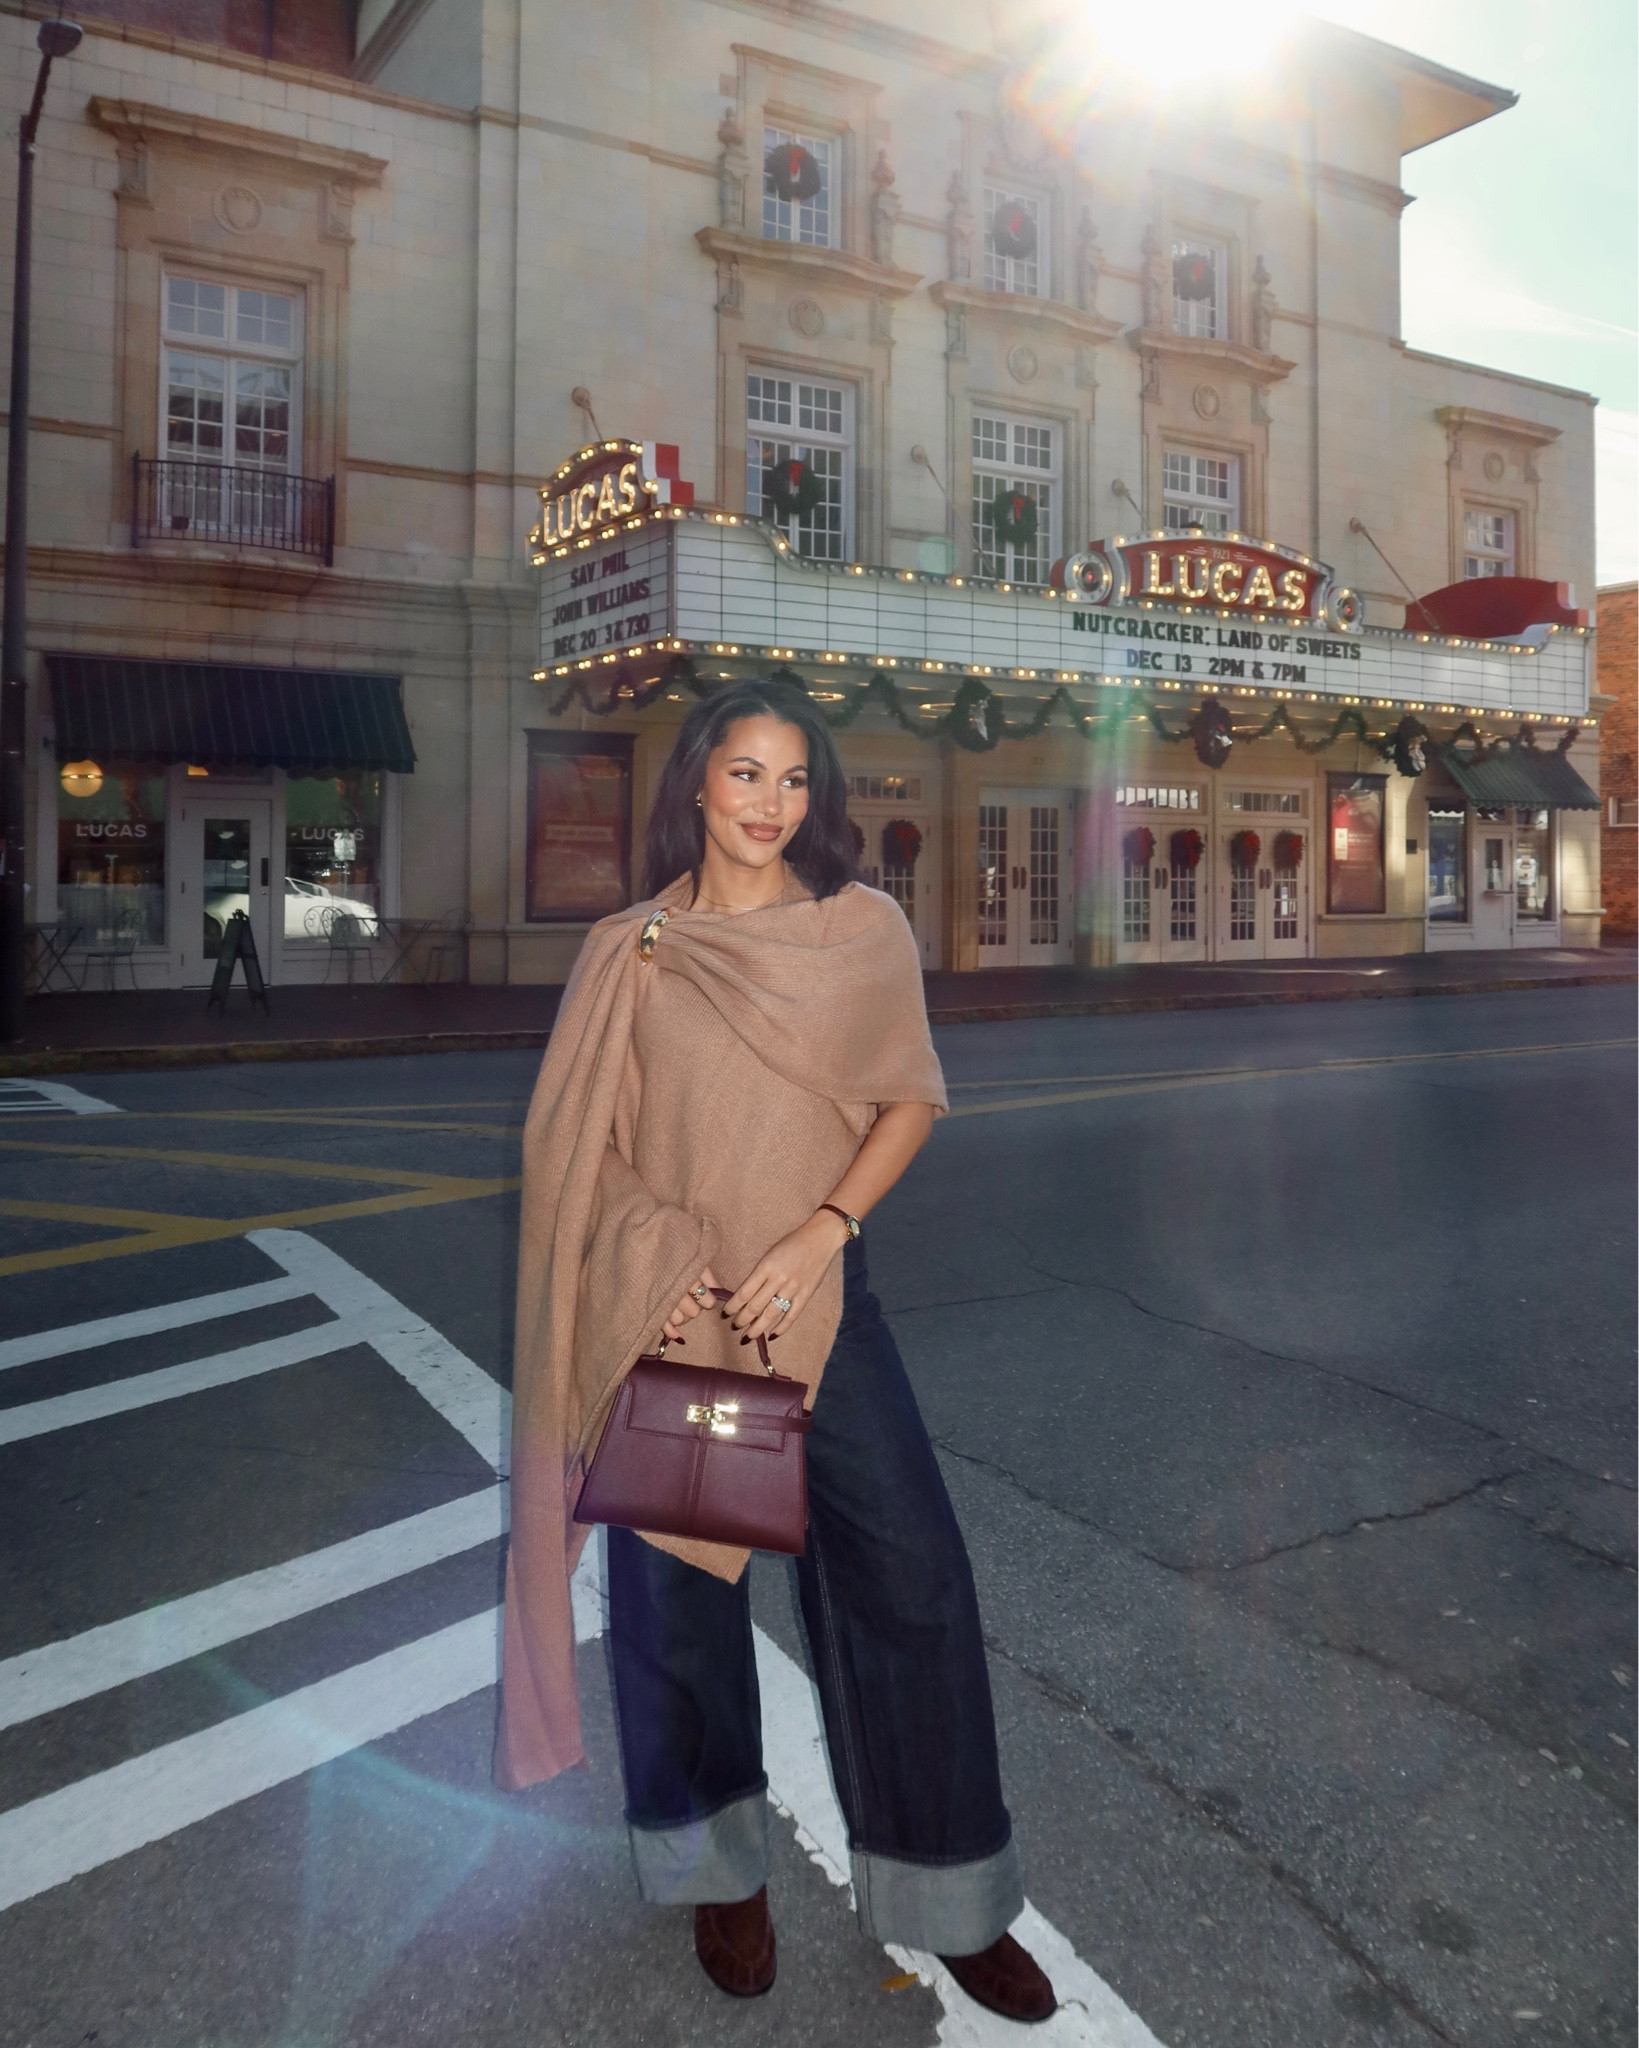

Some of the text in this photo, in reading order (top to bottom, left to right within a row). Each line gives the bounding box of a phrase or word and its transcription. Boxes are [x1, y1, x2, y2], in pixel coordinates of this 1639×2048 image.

[543, 463, 636, 546] LUCAS
[570, 550, 630, 588] SAY PHIL
[1140, 550, 1306, 611] LUCAS
[553, 577, 650, 626] JOHN WILLIAMS
[554, 634, 576, 658] DEC
[580, 628, 597, 651] 20
[1217, 628, 1263, 651] LAND
[1268, 634, 1290, 654] OF
[1296, 637, 1361, 660] SWEETS
[1126, 648, 1306, 683] DEC 13 2PM & 7PM
[76, 824, 148, 838] LUCAS
